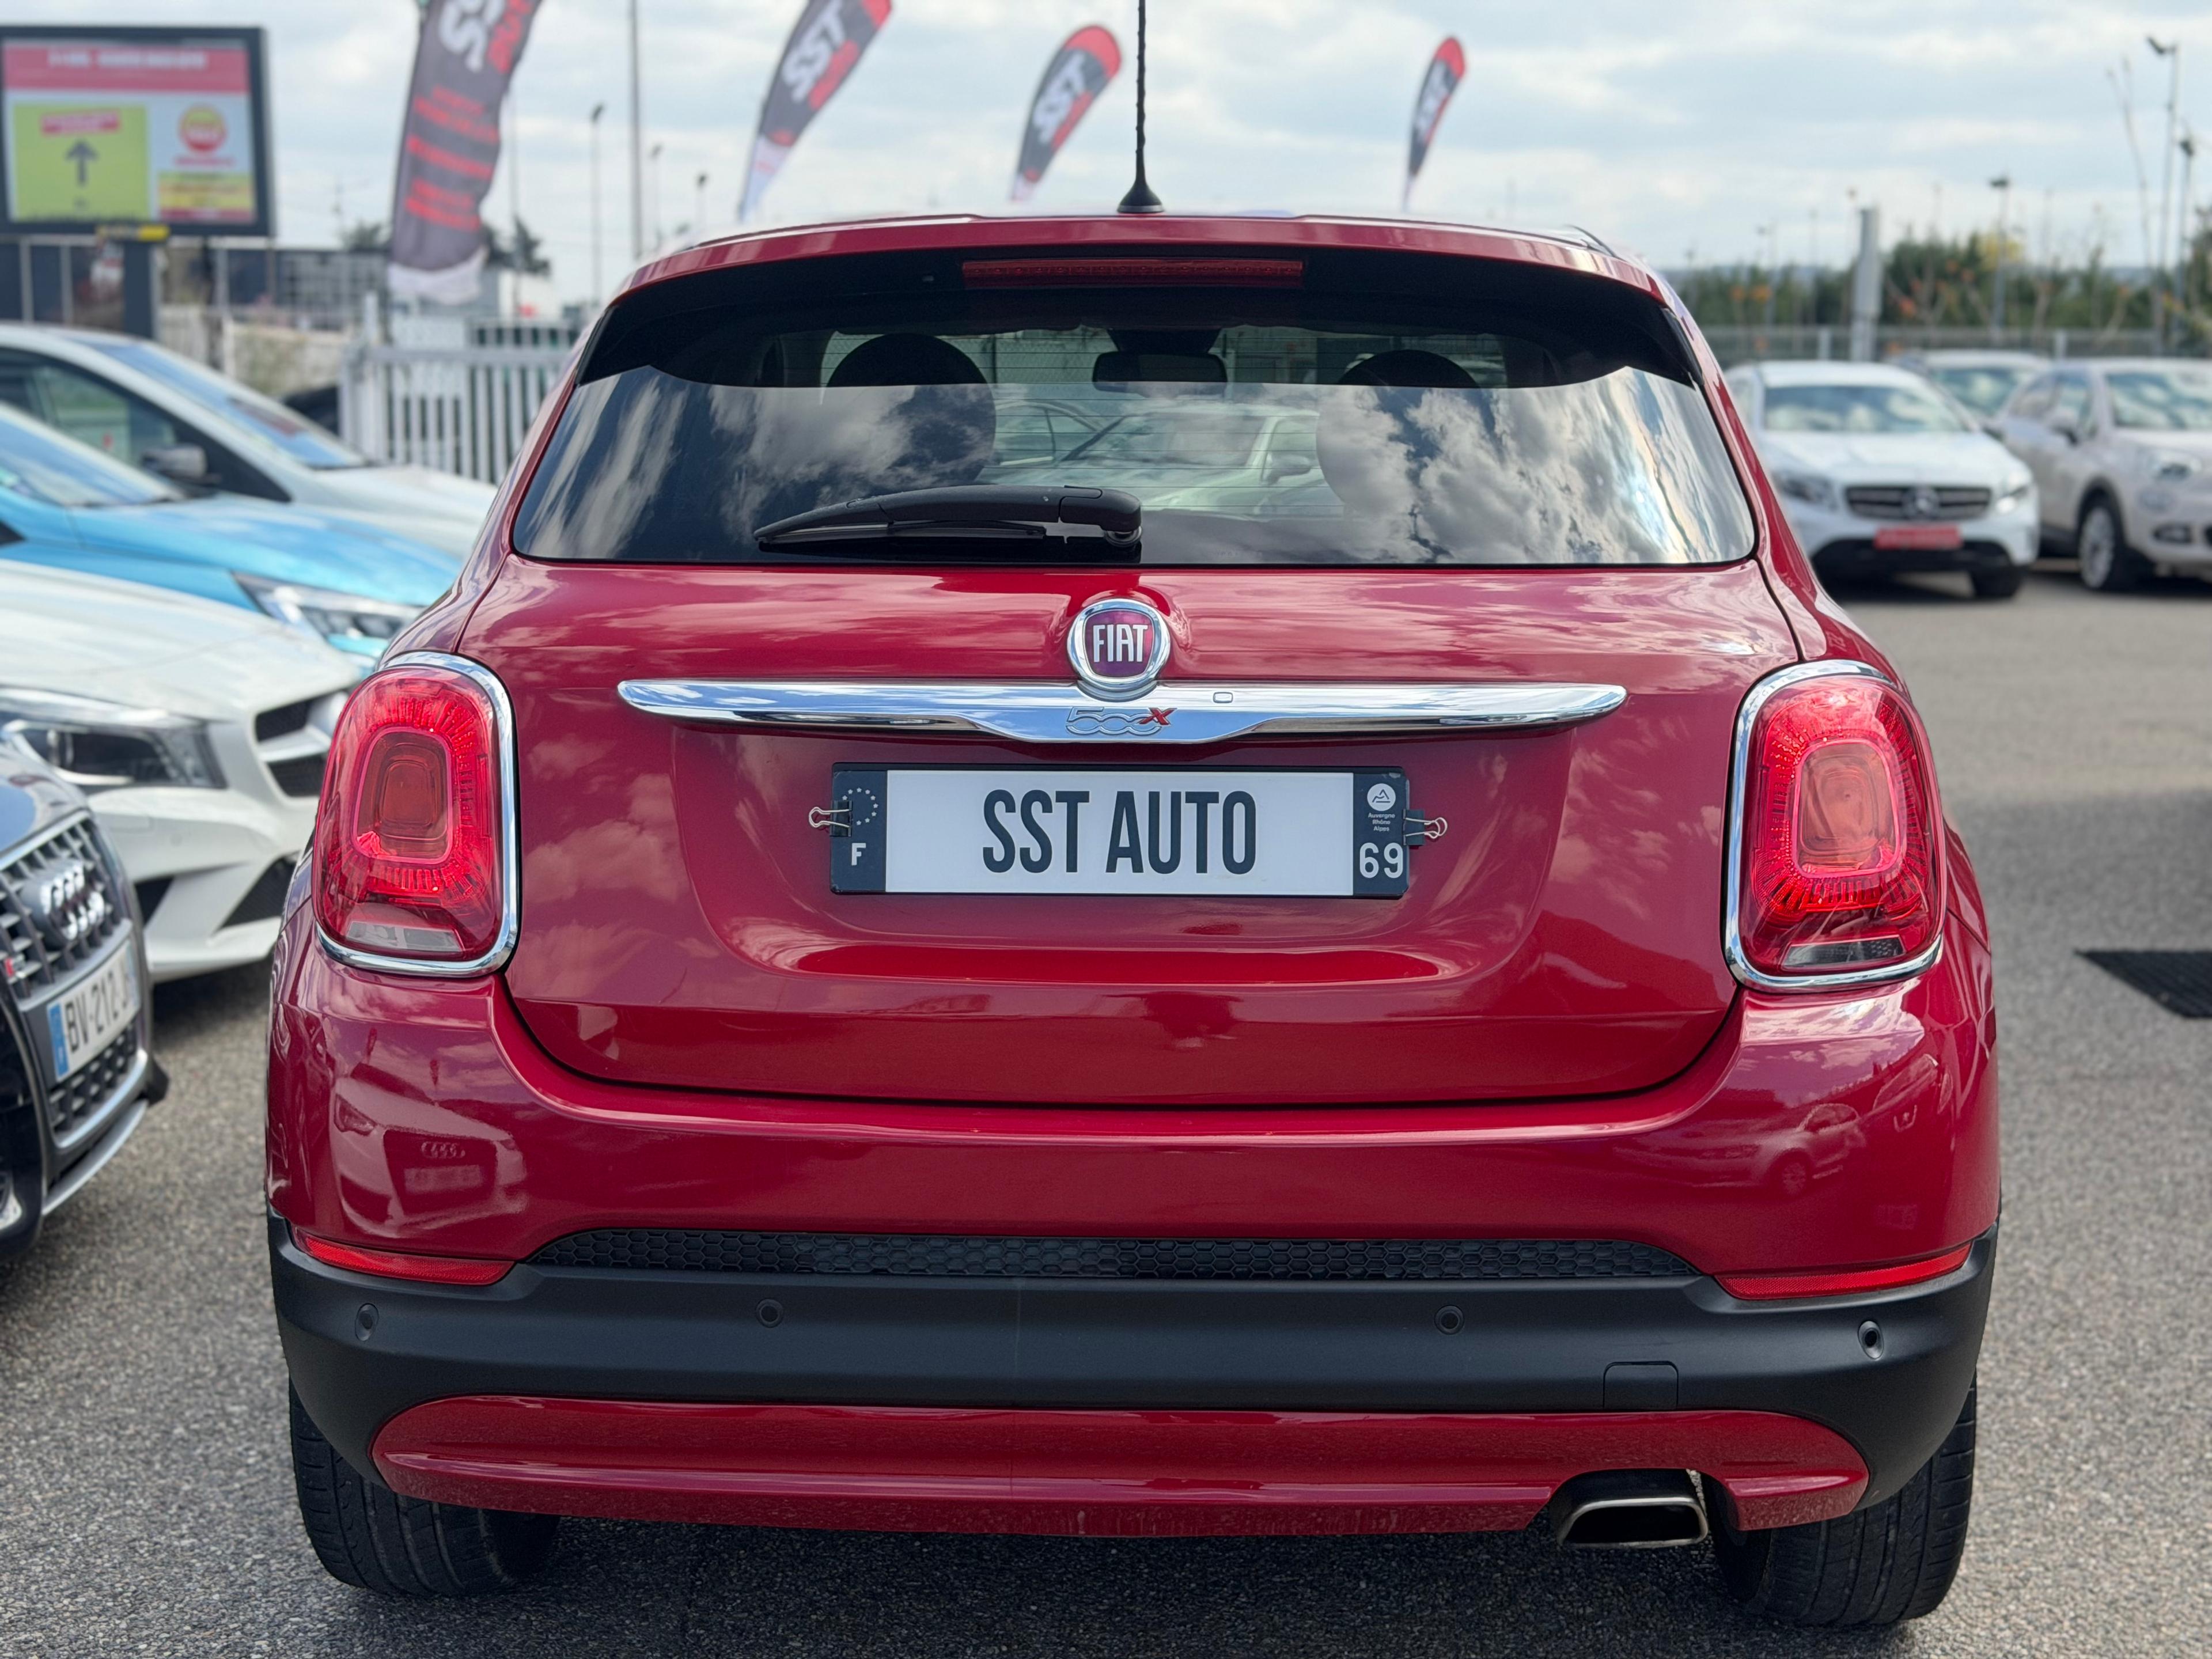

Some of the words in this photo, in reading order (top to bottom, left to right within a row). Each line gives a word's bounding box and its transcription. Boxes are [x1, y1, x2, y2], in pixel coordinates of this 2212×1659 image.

[1093, 624, 1148, 662] FIAT
[982, 789, 1090, 873] SST
[1105, 790, 1256, 874] AUTO
[851, 843, 866, 866] F
[1359, 842, 1403, 878] 69
